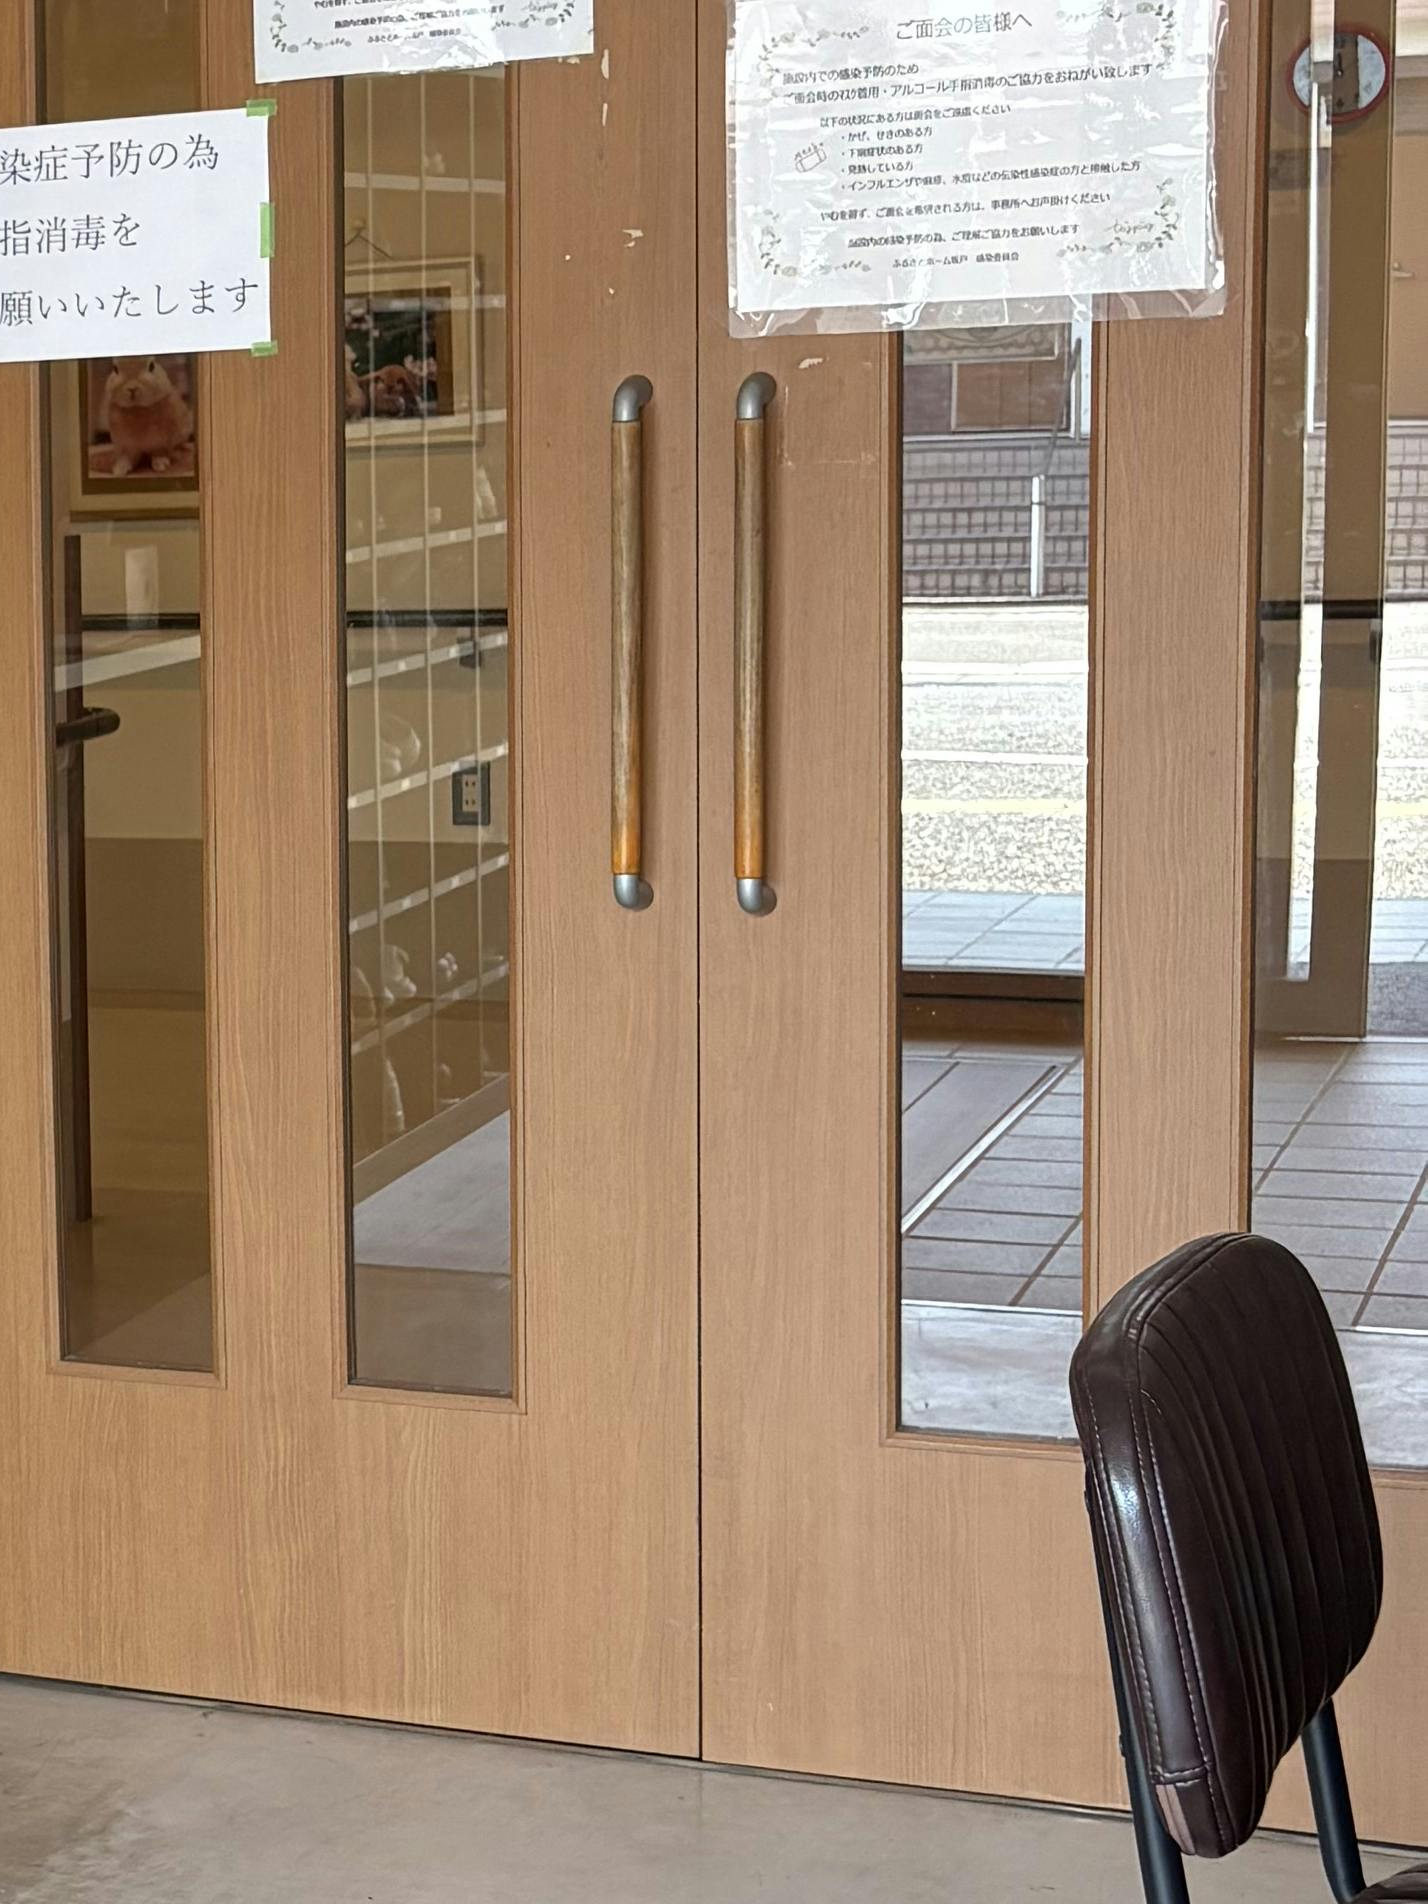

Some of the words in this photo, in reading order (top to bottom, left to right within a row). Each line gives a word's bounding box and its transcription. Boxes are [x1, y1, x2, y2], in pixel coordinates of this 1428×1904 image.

[895, 11, 1034, 41] ご面会の皆様へ
